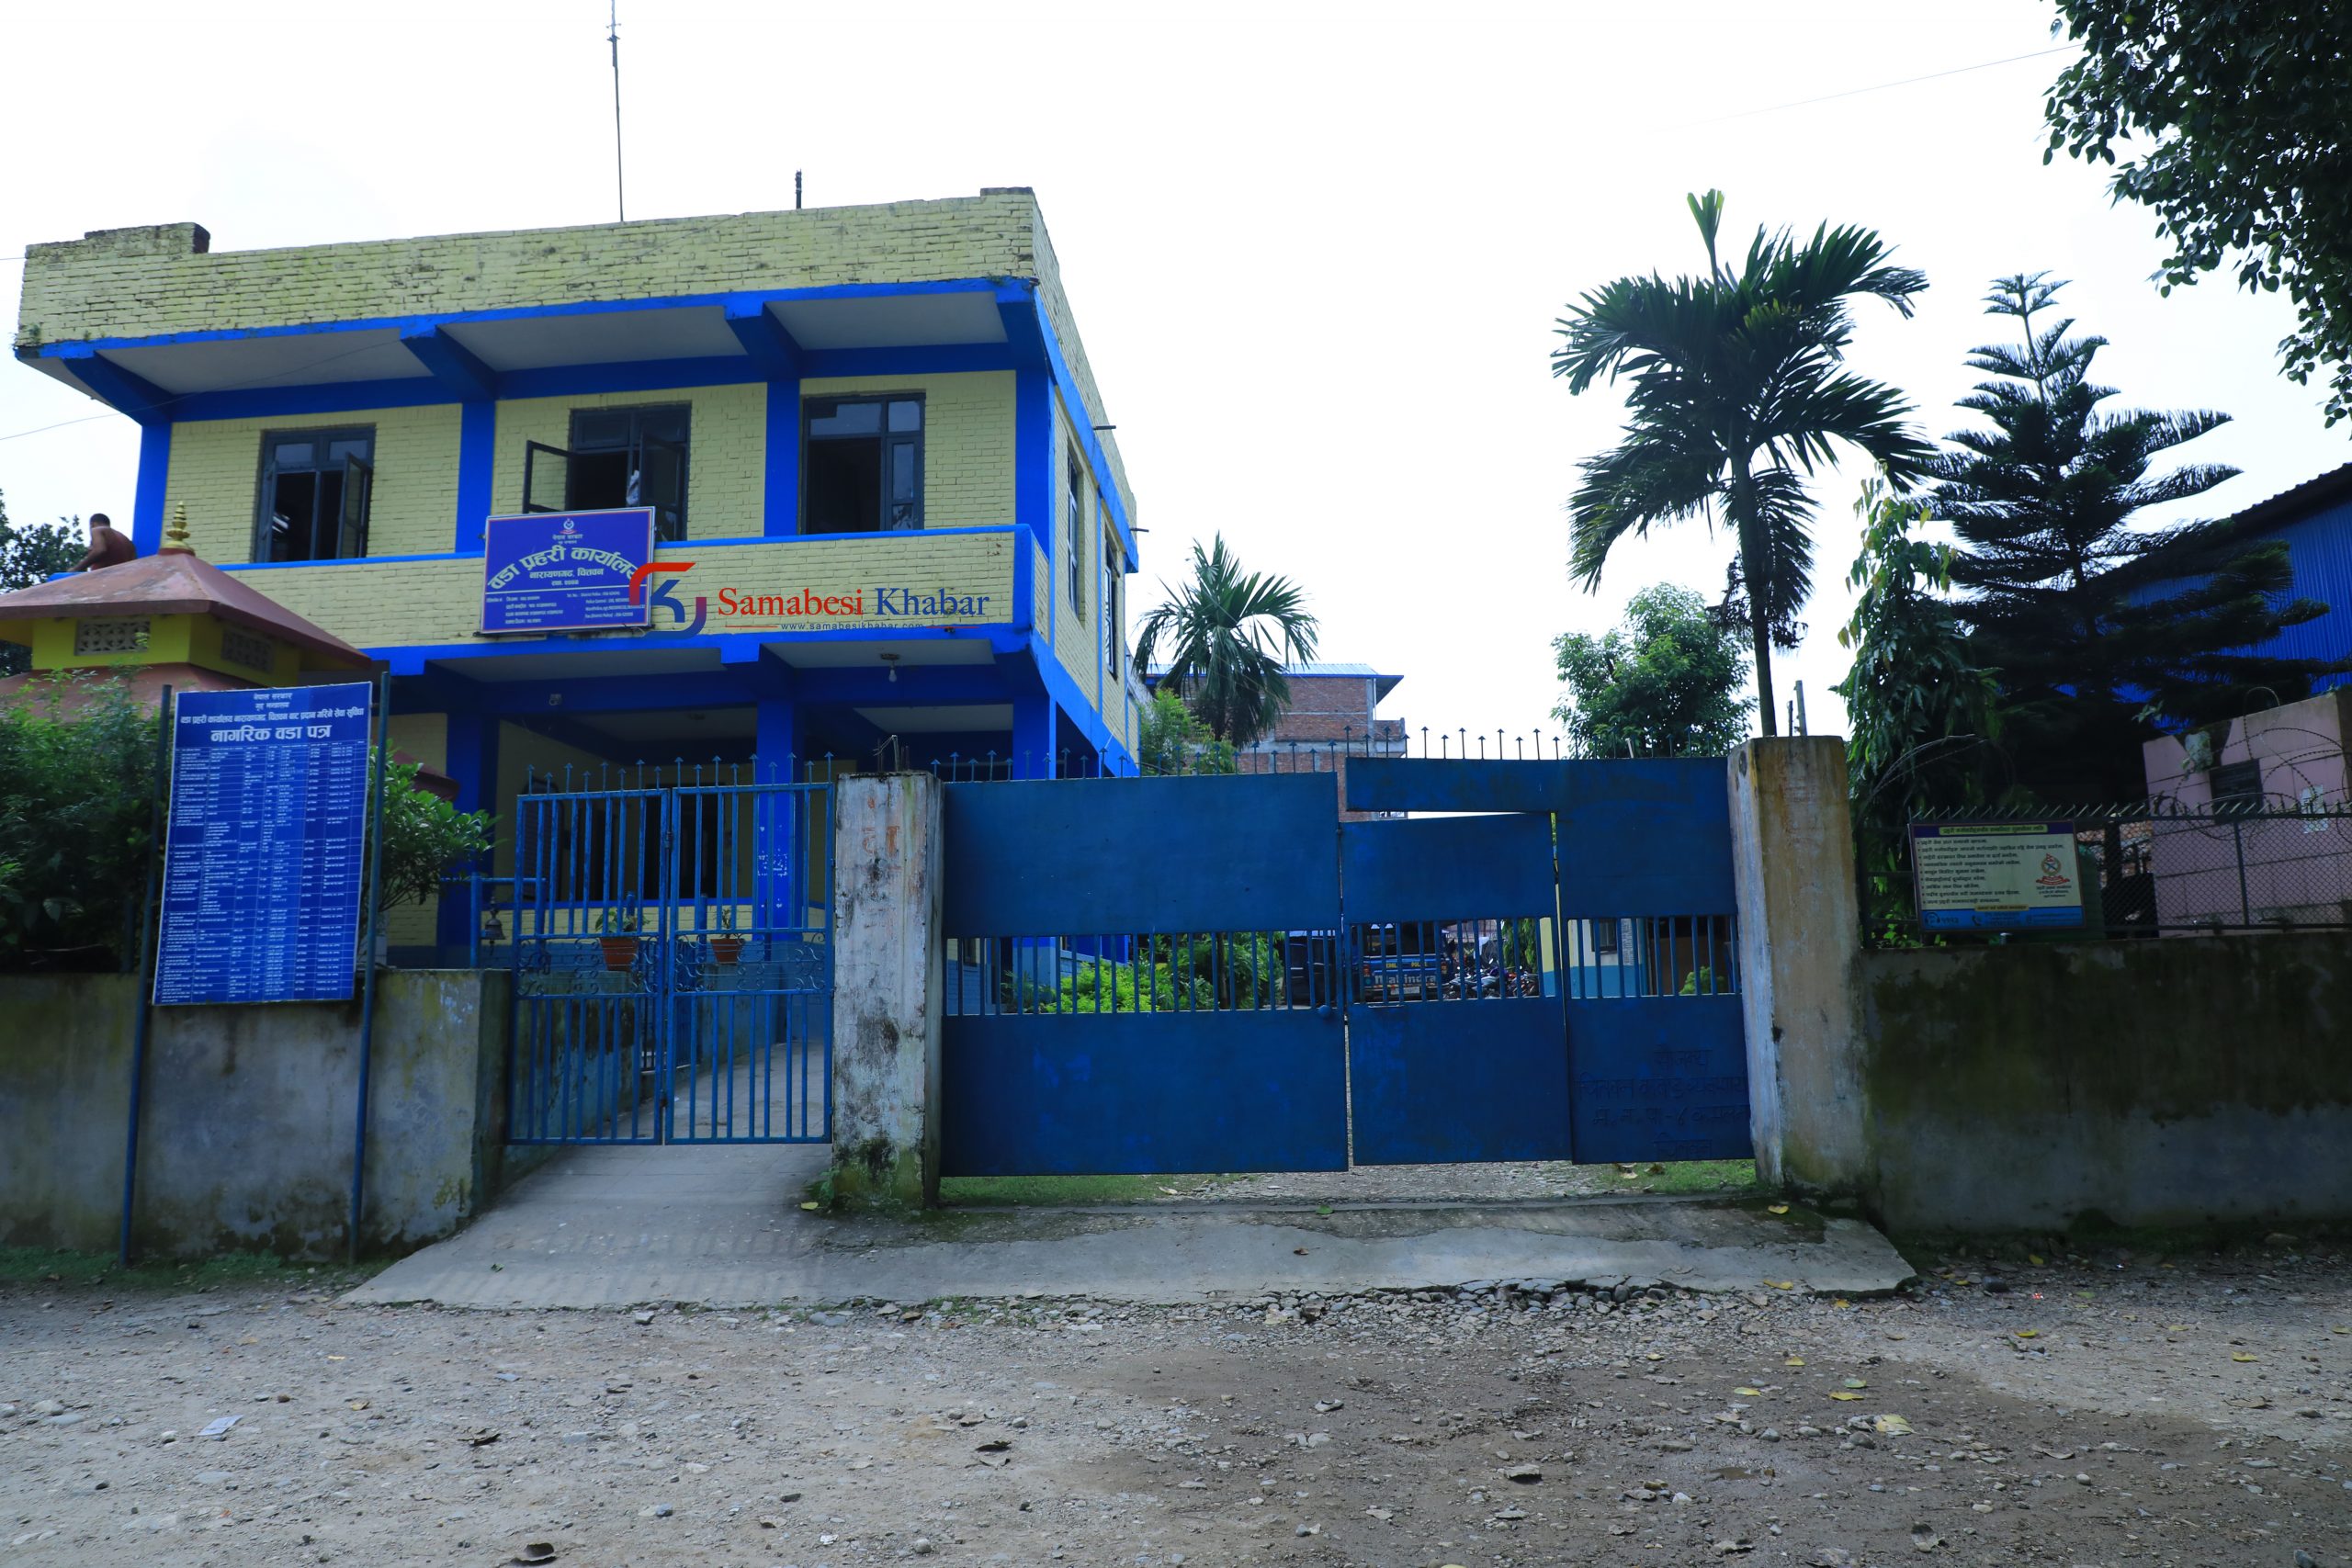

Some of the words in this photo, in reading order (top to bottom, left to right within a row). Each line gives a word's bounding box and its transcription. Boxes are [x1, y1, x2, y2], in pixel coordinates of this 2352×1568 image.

[488, 563, 520, 589] वडा
[519, 545, 566, 570] प्रहरी
[577, 567, 604, 577] चितवन
[210, 724, 272, 742] नागरिक
[275, 726, 303, 740] वडा
[307, 724, 333, 739] पत्र
